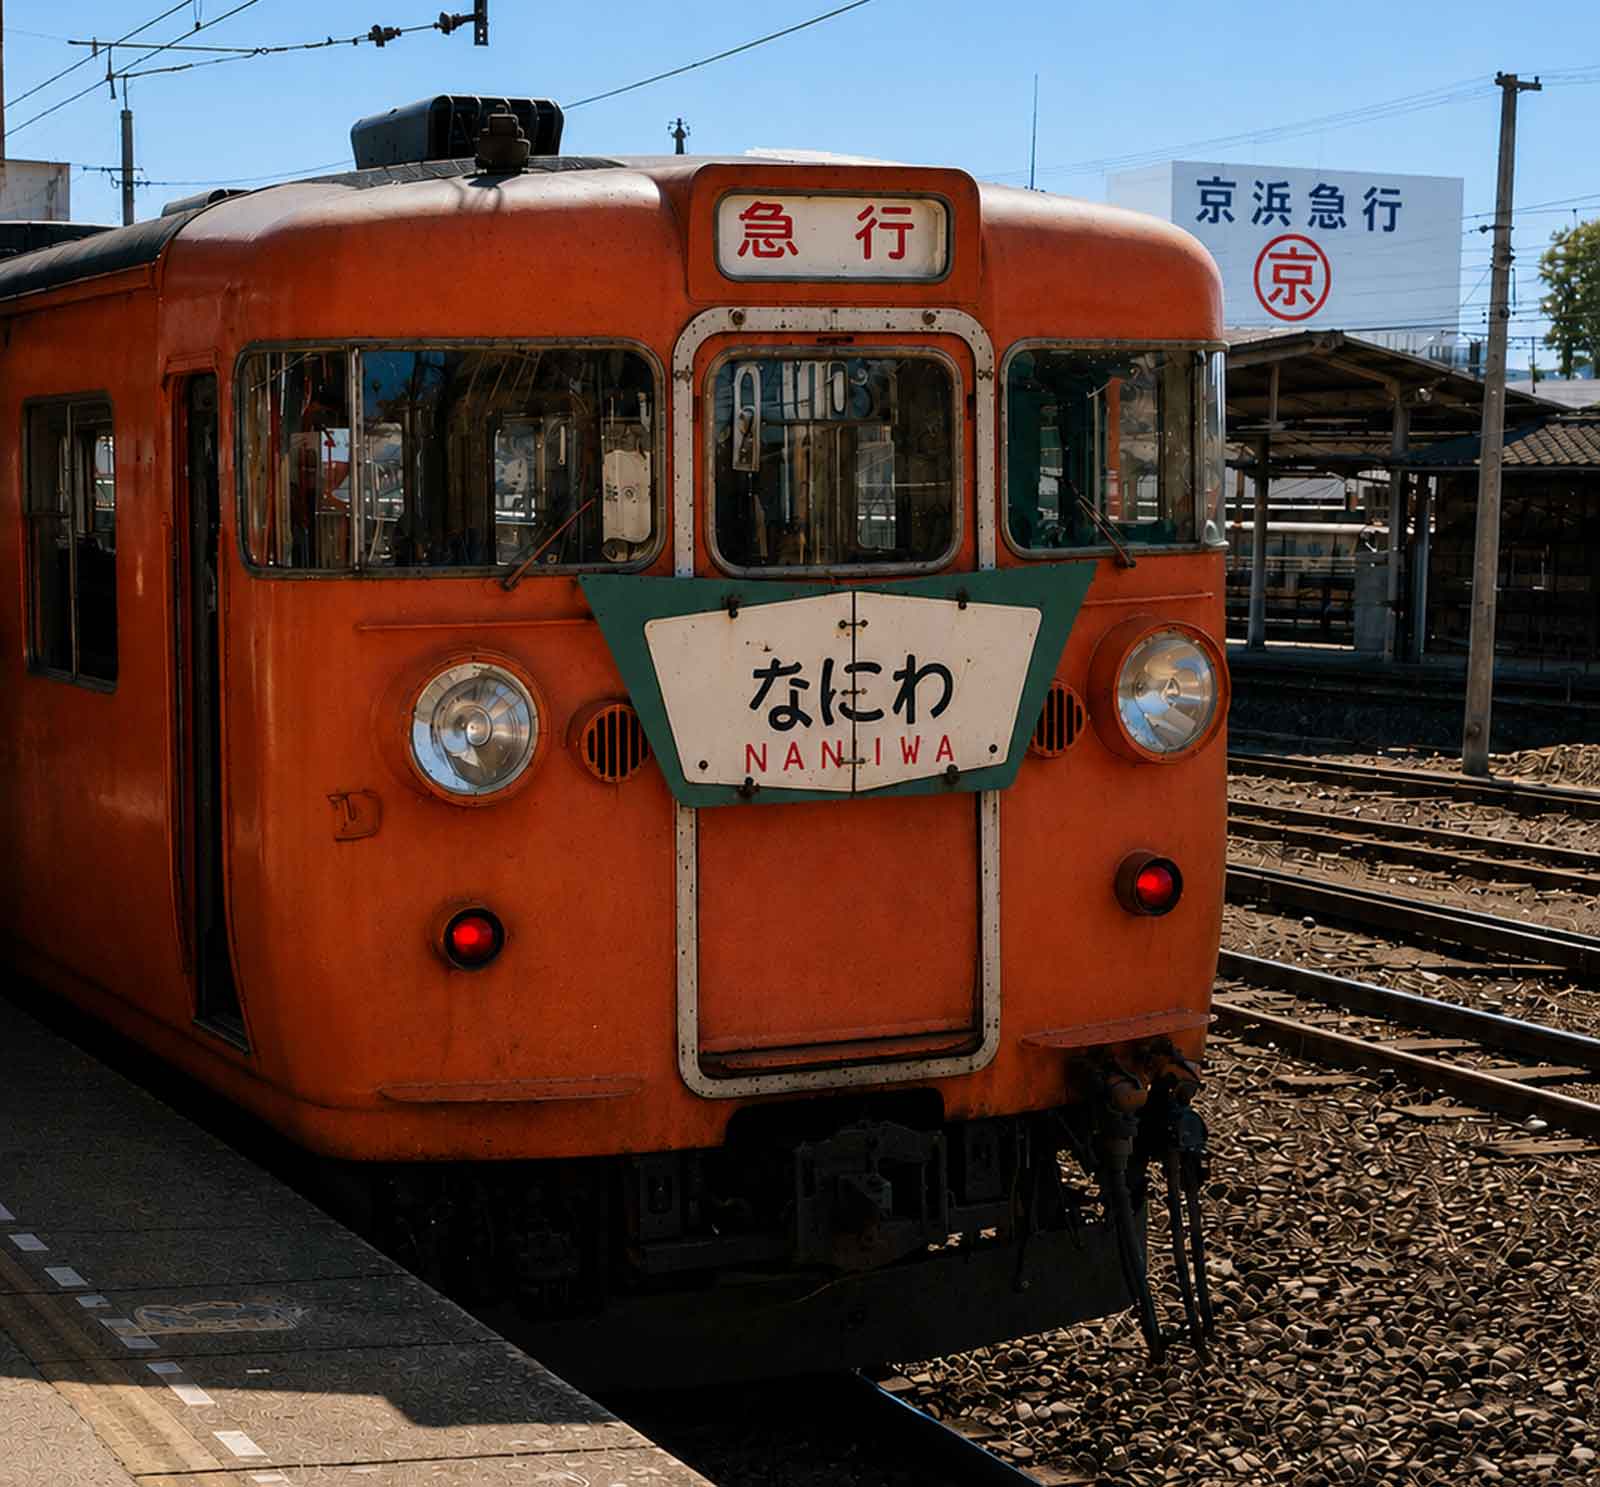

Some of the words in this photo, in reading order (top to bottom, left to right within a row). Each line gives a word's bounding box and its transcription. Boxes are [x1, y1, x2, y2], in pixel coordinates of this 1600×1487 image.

[738, 202, 914, 260] 急行
[1196, 176, 1403, 232] 京浜急行
[1267, 246, 1318, 306] 京
[749, 653, 953, 731] なにわ
[744, 734, 955, 774] NANIWA
